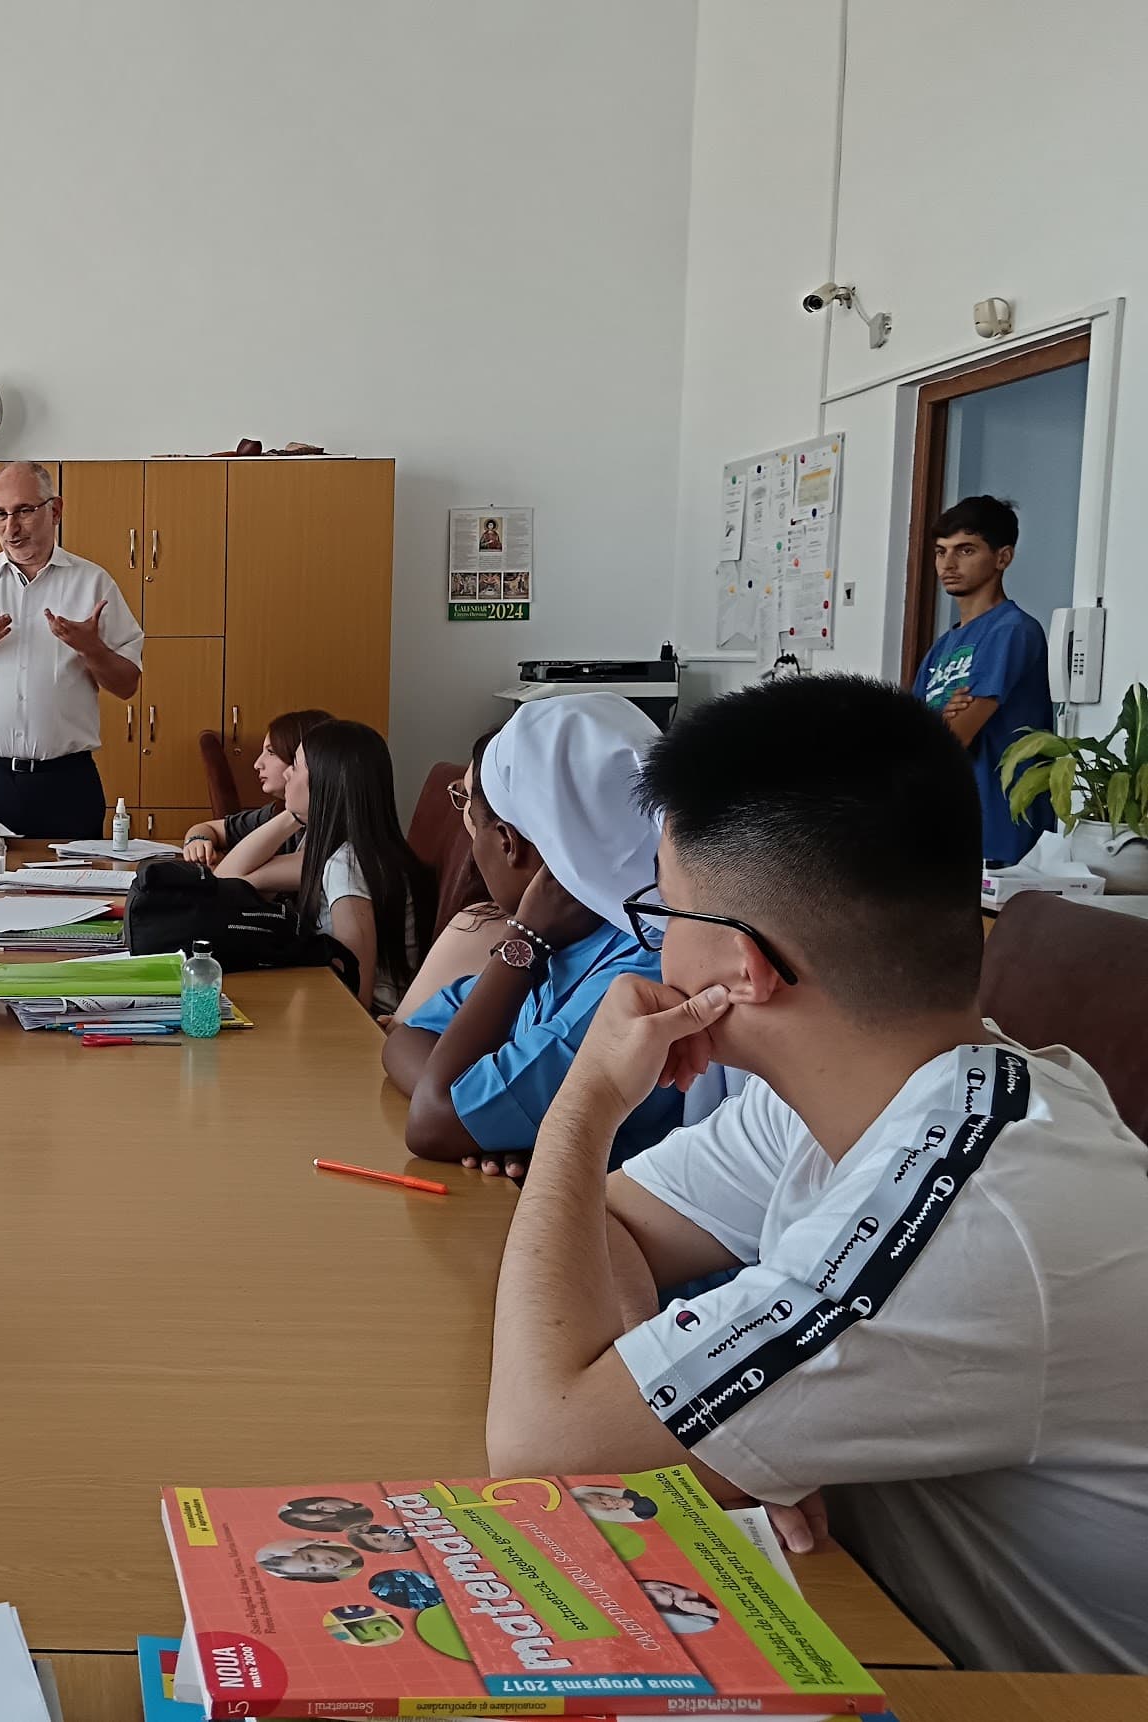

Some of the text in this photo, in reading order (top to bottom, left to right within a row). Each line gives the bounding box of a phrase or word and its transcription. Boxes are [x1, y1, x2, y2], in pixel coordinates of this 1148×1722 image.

[488, 603, 524, 619] 2024
[890, 1175, 955, 1259] Champion
[707, 1299, 794, 1360] Champion
[677, 1367, 765, 1435] Champion
[656, 1473, 706, 1526] individualizate
[463, 1510, 510, 1544] geometrie
[521, 1524, 572, 1562] Semestrul
[698, 1528, 736, 1554] planuri
[727, 1556, 753, 1574] prin
[381, 1493, 571, 1669] matematică
[600, 1601, 626, 1614] DE
[736, 1593, 763, 1617] lucru
[741, 1576, 802, 1635] suplimentară
[615, 1618, 660, 1650] CAIET
[754, 1619, 773, 1630] de
[212, 1647, 244, 1686] NOUA
[249, 1668, 261, 1687] mate
[503, 1678, 695, 1695] noua programă 2017
[315, 1702, 374, 1713] Semestrul
[416, 1702, 477, 1712] aprofundare
[489, 1702, 547, 1710] consolidare
[667, 1698, 762, 1711] matematică
